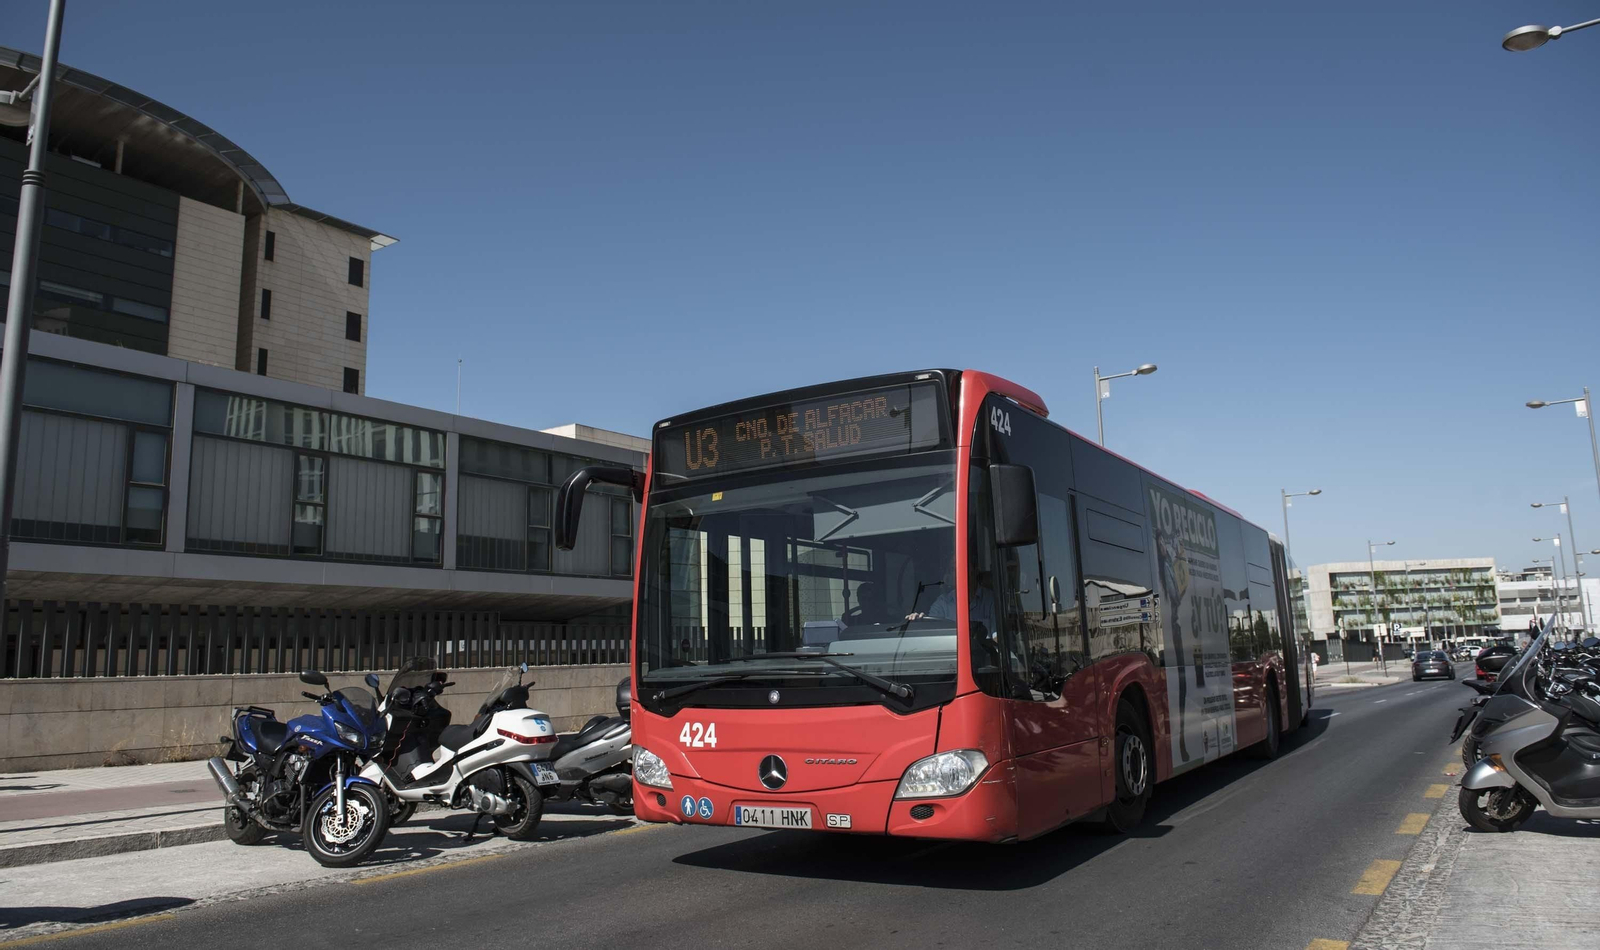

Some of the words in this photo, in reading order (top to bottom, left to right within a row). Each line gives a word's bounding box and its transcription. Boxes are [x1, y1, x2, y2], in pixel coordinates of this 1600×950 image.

[777, 412, 800, 435] DE
[804, 396, 888, 430] ALFACAR
[990, 406, 1012, 437] 424
[685, 427, 720, 470] U3
[759, 439, 777, 459] P.
[781, 435, 798, 456] T.
[803, 423, 861, 451] SALUD
[1149, 489, 1172, 535] YO
[1172, 502, 1216, 551] RECICLO
[679, 722, 717, 748] 424
[804, 758, 858, 766] CITARO
[742, 808, 775, 825] 0411
[781, 810, 809, 827] HNK
[828, 815, 849, 826] SP
